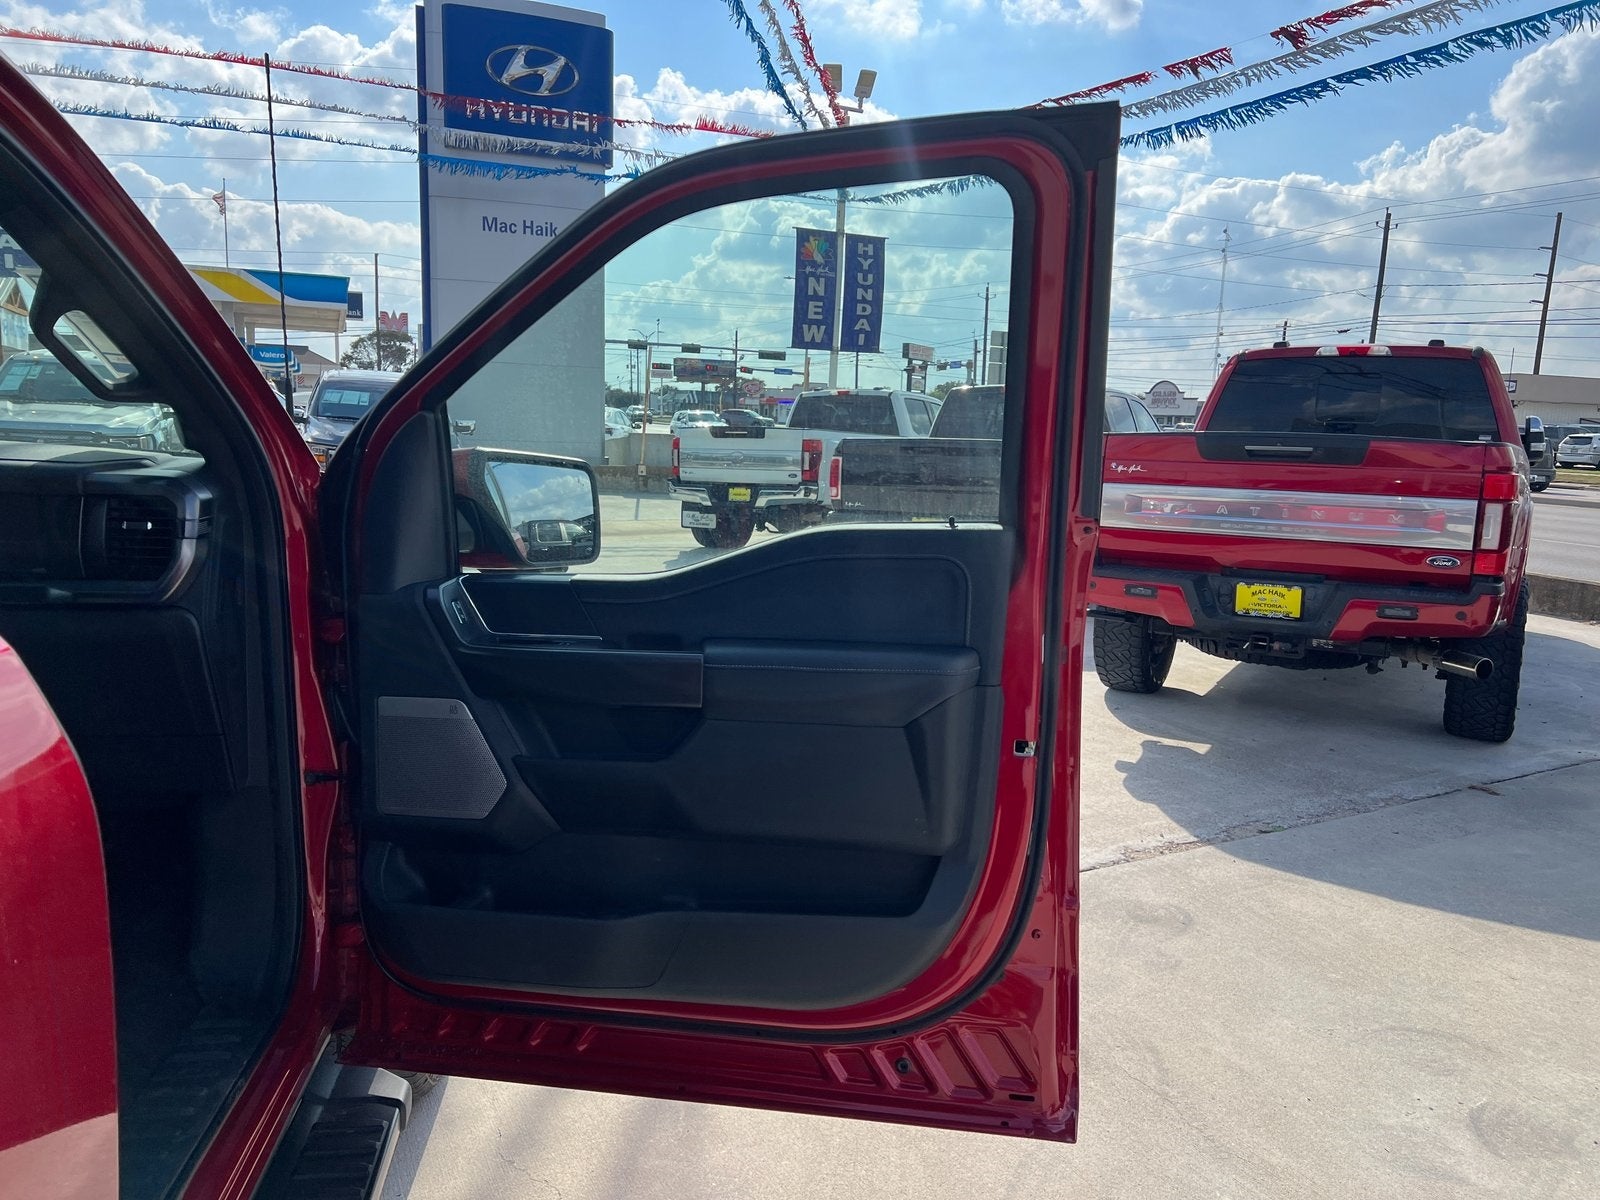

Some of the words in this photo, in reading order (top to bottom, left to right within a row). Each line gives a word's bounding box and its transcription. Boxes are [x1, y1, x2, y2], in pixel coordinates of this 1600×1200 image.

[466, 98, 598, 133] HYUNDAI
[482, 215, 518, 235] Mac
[522, 219, 558, 238] Haik
[854, 242, 874, 345] HYUNDAI
[802, 276, 826, 343] NEW
[259, 351, 285, 359] Valero
[1433, 557, 1453, 566] Ford
[1251, 589, 1267, 597] MAC
